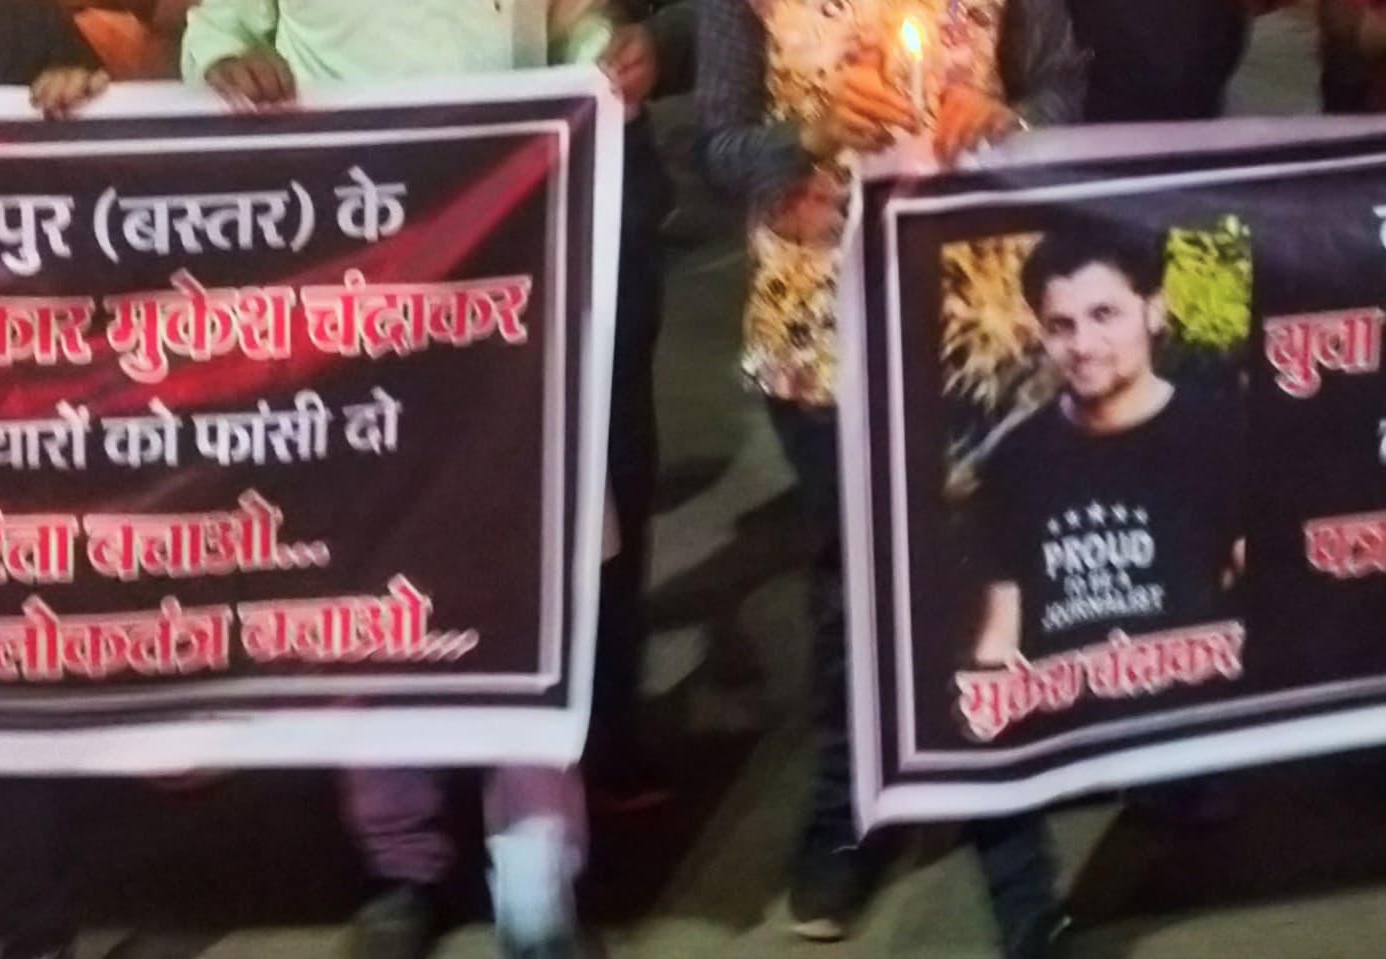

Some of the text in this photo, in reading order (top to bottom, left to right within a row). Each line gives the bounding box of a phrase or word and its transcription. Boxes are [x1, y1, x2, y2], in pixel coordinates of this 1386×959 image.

[94, 181, 316, 263] (बस्तर)
[335, 165, 405, 242] के
[104, 268, 295, 384] मुकेश
[301, 268, 532, 360] चंद्राकर
[1265, 308, 1384, 399] युवा
[101, 398, 180, 469] को
[194, 389, 330, 467] फांसी
[344, 386, 402, 455] दो
[1042, 528, 1156, 581] PROUD
